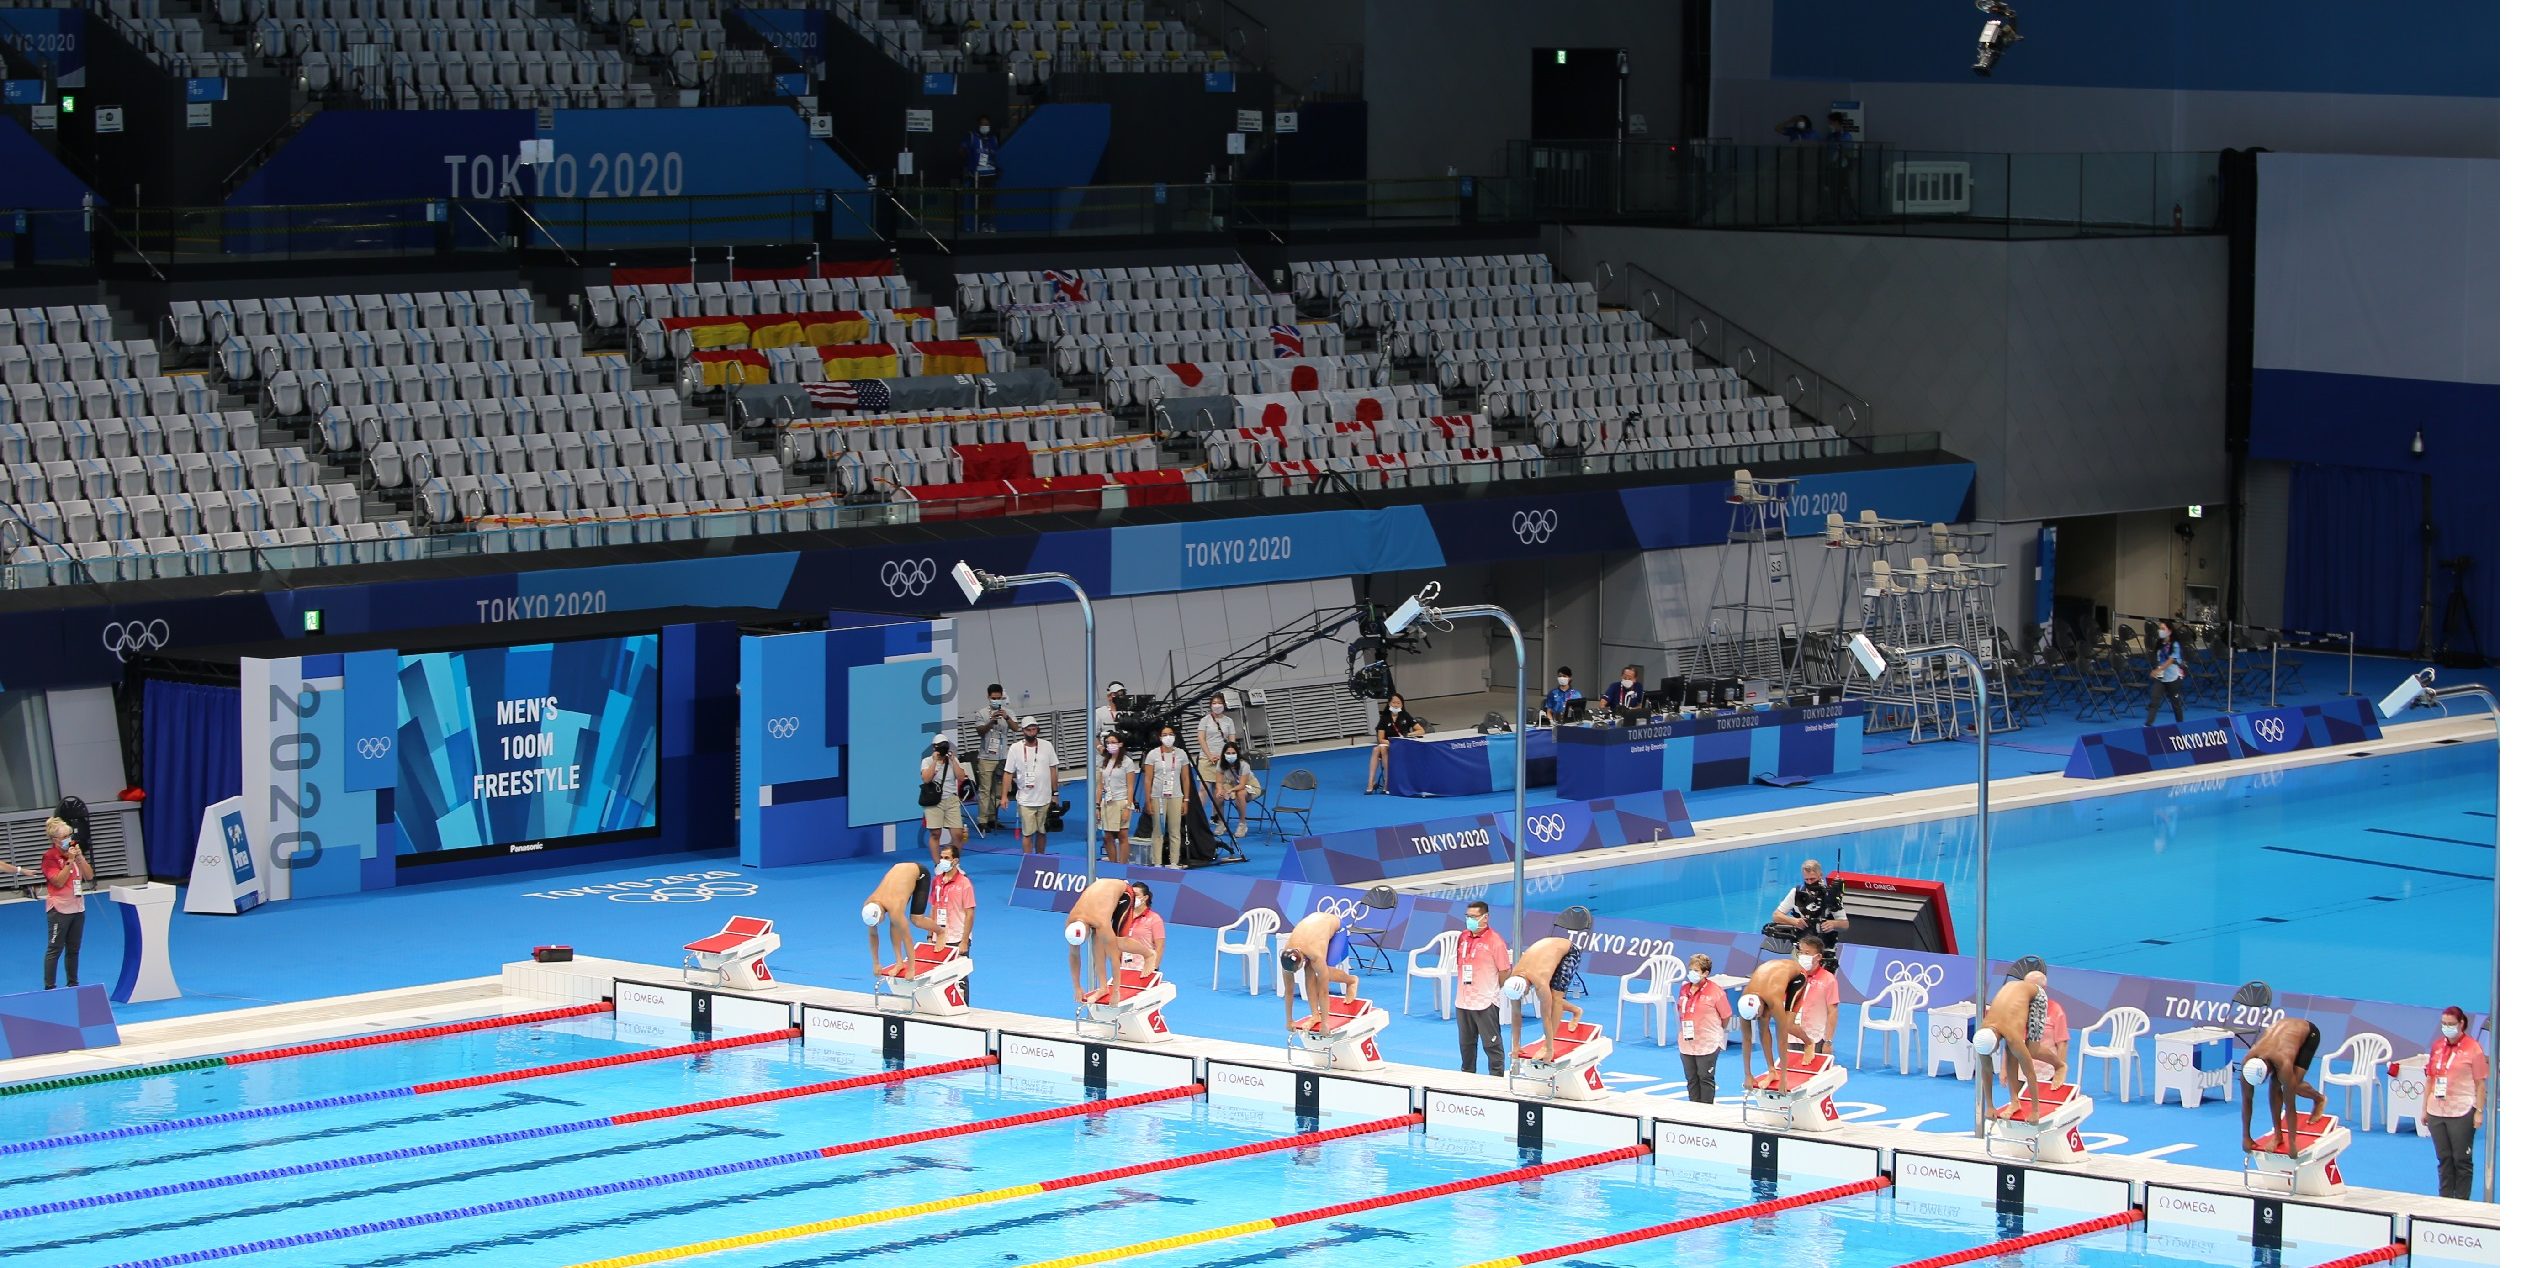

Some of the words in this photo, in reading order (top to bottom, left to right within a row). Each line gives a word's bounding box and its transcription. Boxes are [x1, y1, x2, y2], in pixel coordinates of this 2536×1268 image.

[38, 33, 75, 52] 2020
[784, 32, 817, 48] 2020
[444, 153, 577, 199] TOKYO
[588, 151, 684, 198] 2020
[1812, 491, 1848, 516] 2020
[1185, 539, 1244, 568] TOKYO
[1248, 535, 1291, 562] 2020
[1770, 560, 1782, 573] S3
[476, 594, 549, 624] TOKYO
[554, 589, 607, 617] 2020
[1980, 646, 1991, 658] E2
[1802, 708, 1826, 720] TOKYO
[1826, 705, 1843, 717] 2020
[1716, 717, 1741, 731] TOKYO
[1741, 715, 1759, 729] 2020
[1627, 727, 1653, 741] TOKYO
[1653, 725, 1672, 738] 2020
[2168, 732, 2203, 751] TOKYO
[2202, 729, 2228, 747] 2020
[500, 732, 554, 761] 100M
[269, 682, 323, 870] 2020
[473, 765, 580, 800] FREESTYLE
[509, 841, 544, 853] Panasonic
[1411, 832, 1457, 855] TOKYO
[1457, 828, 1490, 849] 2020
[522, 881, 653, 900] TOKYO
[645, 869, 742, 886] 2020
[1033, 869, 1087, 893] TOKYO
[1873, 883, 1897, 892] OMEGA
[1567, 929, 1626, 955] TOKYO
[1626, 936, 1674, 957] 2020
[756, 963, 764, 979] 0
[633, 992, 665, 1006] OMEGA
[950, 988, 957, 1004] 1
[2165, 996, 2231, 1024] TOKYO
[2233, 1004, 2285, 1029] 2020
[822, 1018, 855, 1032] OMEGA
[1153, 1015, 1162, 1031] 2
[1020, 1046, 1056, 1060] OMEGA
[1365, 1043, 1373, 1059] 3
[1228, 1073, 1265, 1088] OMEGA
[1588, 1071, 1597, 1087] 4
[2197, 1068, 2229, 1090] 2020
[1447, 1103, 1486, 1118] OMEGA
[1824, 1100, 1833, 1118] 5
[1677, 1131, 1719, 1150] OMEGA
[2070, 1131, 2079, 1149] 6
[1919, 1165, 1961, 1181] OMEGA
[2329, 1164, 2336, 1182] 7
[2173, 1198, 2216, 1215] OMEGA
[2437, 1232, 2484, 1250] OMEGA
